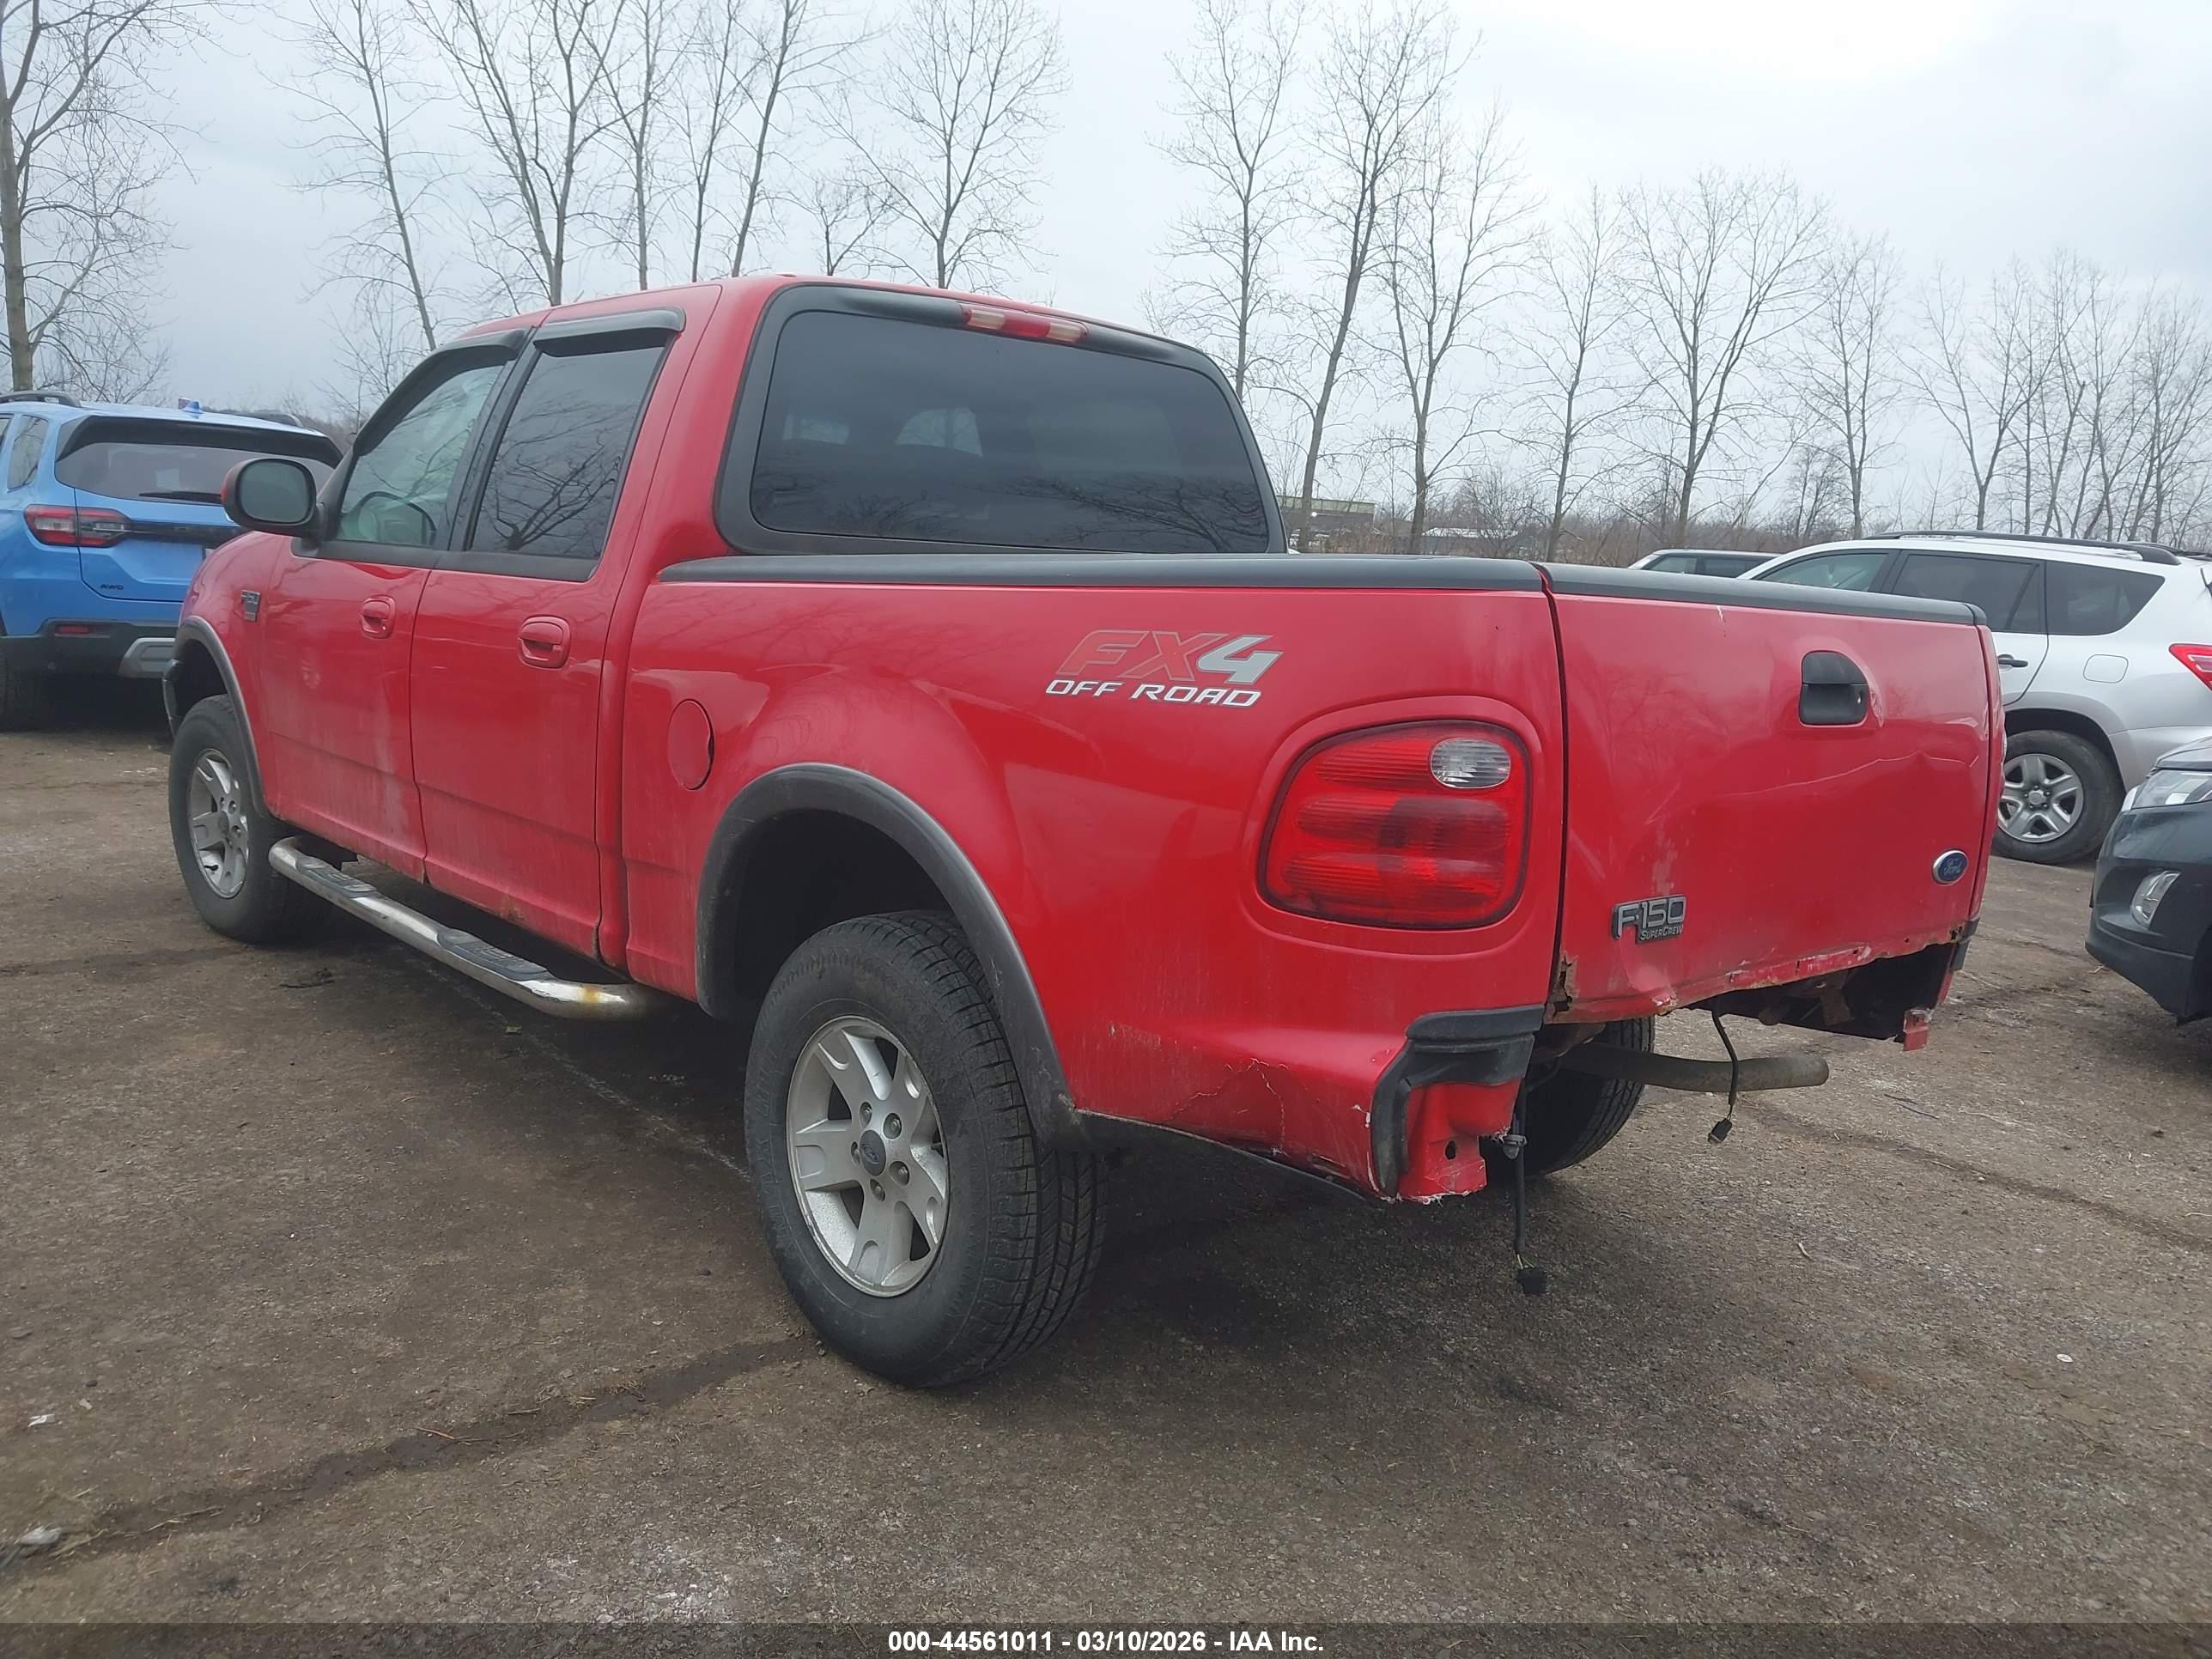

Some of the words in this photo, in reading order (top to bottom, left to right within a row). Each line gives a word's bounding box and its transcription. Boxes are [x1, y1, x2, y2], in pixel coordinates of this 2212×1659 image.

[1056, 630, 1284, 684] FX4
[1045, 679, 1121, 696] OFF
[1129, 684, 1261, 707] ROAD
